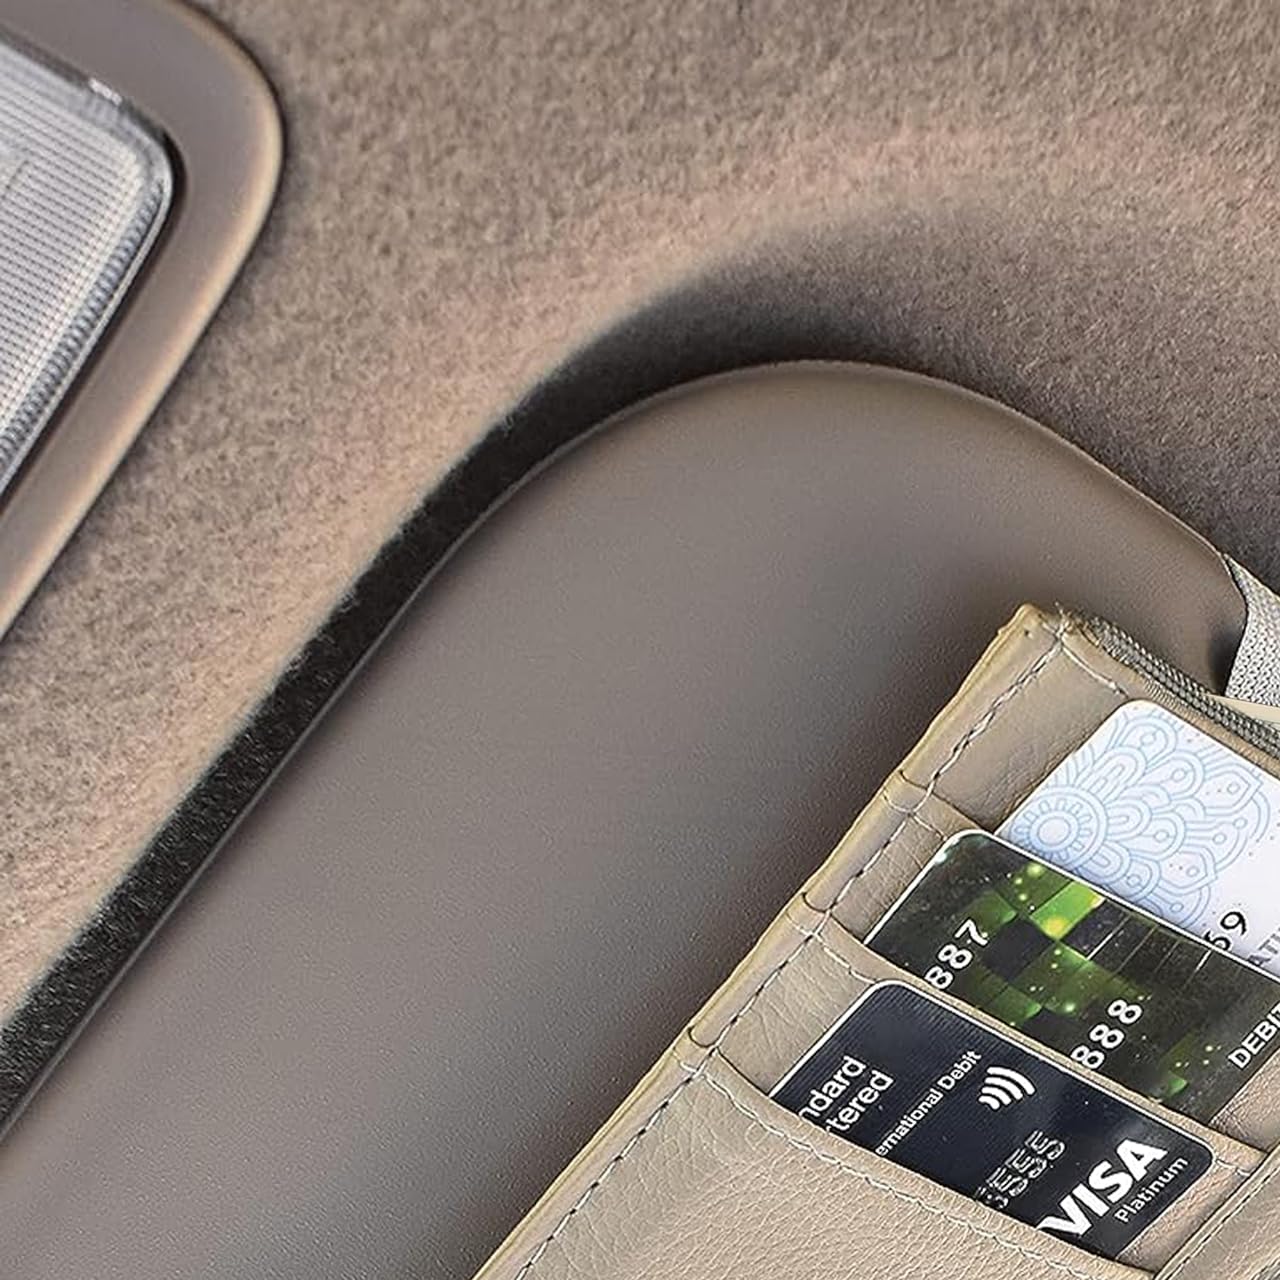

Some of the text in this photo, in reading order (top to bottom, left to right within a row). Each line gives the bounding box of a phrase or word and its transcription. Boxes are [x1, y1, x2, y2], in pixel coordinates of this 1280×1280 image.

[1069, 999, 1145, 1071] 888
[936, 1050, 982, 1091] Debit
[1037, 1138, 1169, 1237] VISA
[1114, 1157, 1190, 1224] Platinum
